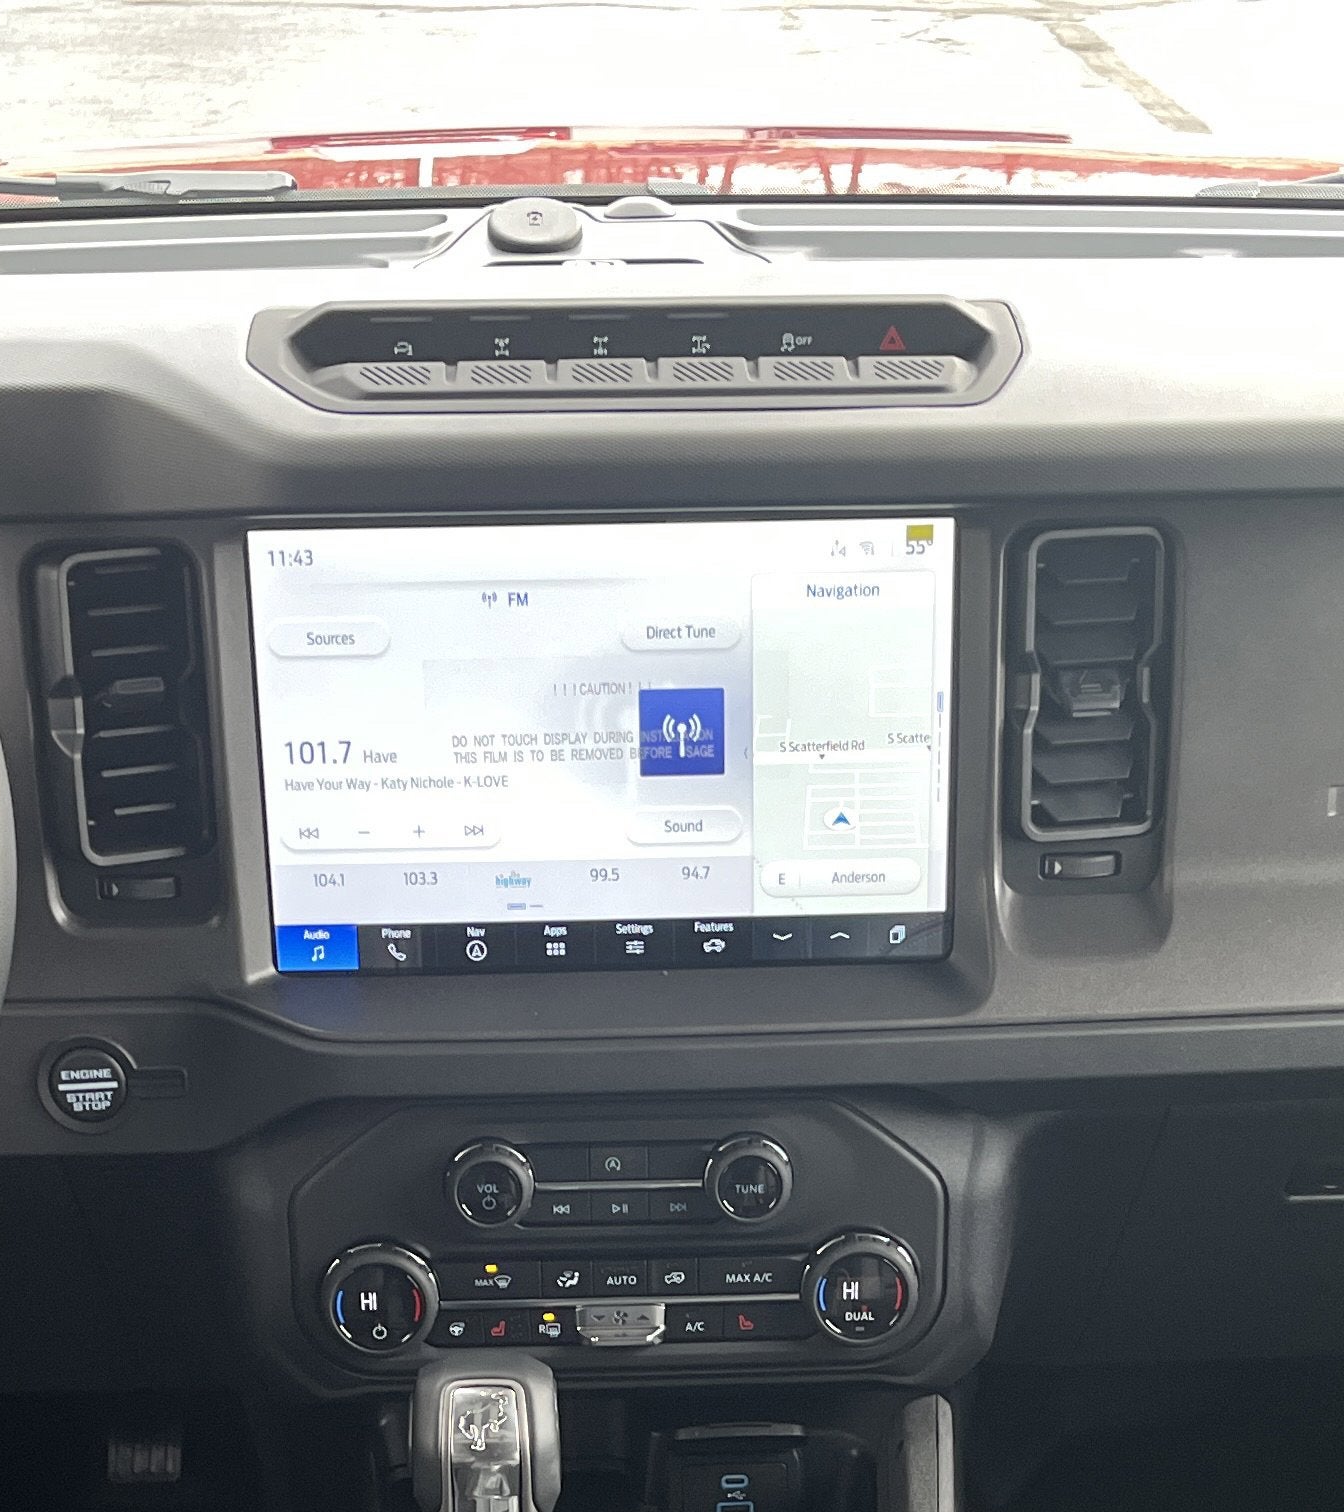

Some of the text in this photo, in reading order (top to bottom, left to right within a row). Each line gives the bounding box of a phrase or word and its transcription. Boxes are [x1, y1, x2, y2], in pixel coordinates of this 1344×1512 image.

[267, 549, 314, 567] 11:43
[806, 584, 880, 600] Navigation
[507, 592, 529, 607] FM
[306, 631, 355, 646] Sources
[646, 626, 716, 640] Direct Tune
[452, 731, 634, 748] DO NOT TOUCH DISPLAY DURING
[887, 733, 894, 744] S
[283, 741, 352, 765] 101.7
[780, 740, 865, 753] S Scatterfield Rd
[363, 750, 398, 764] Have
[454, 746, 673, 764] THIS FILM IS TO BE REMOVED BEFORE
[284, 775, 509, 792] Have Your Way Katy Nichole K-LOVE
[664, 819, 703, 833] Sound
[313, 873, 345, 887] 104.1
[404, 871, 438, 885] 103.3
[590, 867, 619, 882] 99.5
[681, 866, 710, 881] 94.7
[778, 872, 786, 885] E
[832, 871, 886, 885] Anderson
[381, 928, 411, 939] Phone
[466, 926, 485, 937] Nav
[543, 925, 567, 938] Apps
[615, 923, 654, 936] Settings
[694, 921, 734, 934] Features
[303, 929, 330, 941] Audio
[60, 1068, 112, 1081] ENGINE
[66, 1091, 114, 1103] START
[73, 1100, 111, 1112] STOP
[476, 1183, 499, 1194] VOL
[735, 1184, 765, 1195] TUNE
[474, 1278, 494, 1287] MAX
[606, 1274, 637, 1286] AUTO
[725, 1271, 773, 1284] MAX A/C
[842, 1281, 859, 1300] HI
[360, 1292, 377, 1311] HI
[844, 1311, 875, 1322] DUAL
[685, 1320, 705, 1332] A/C
